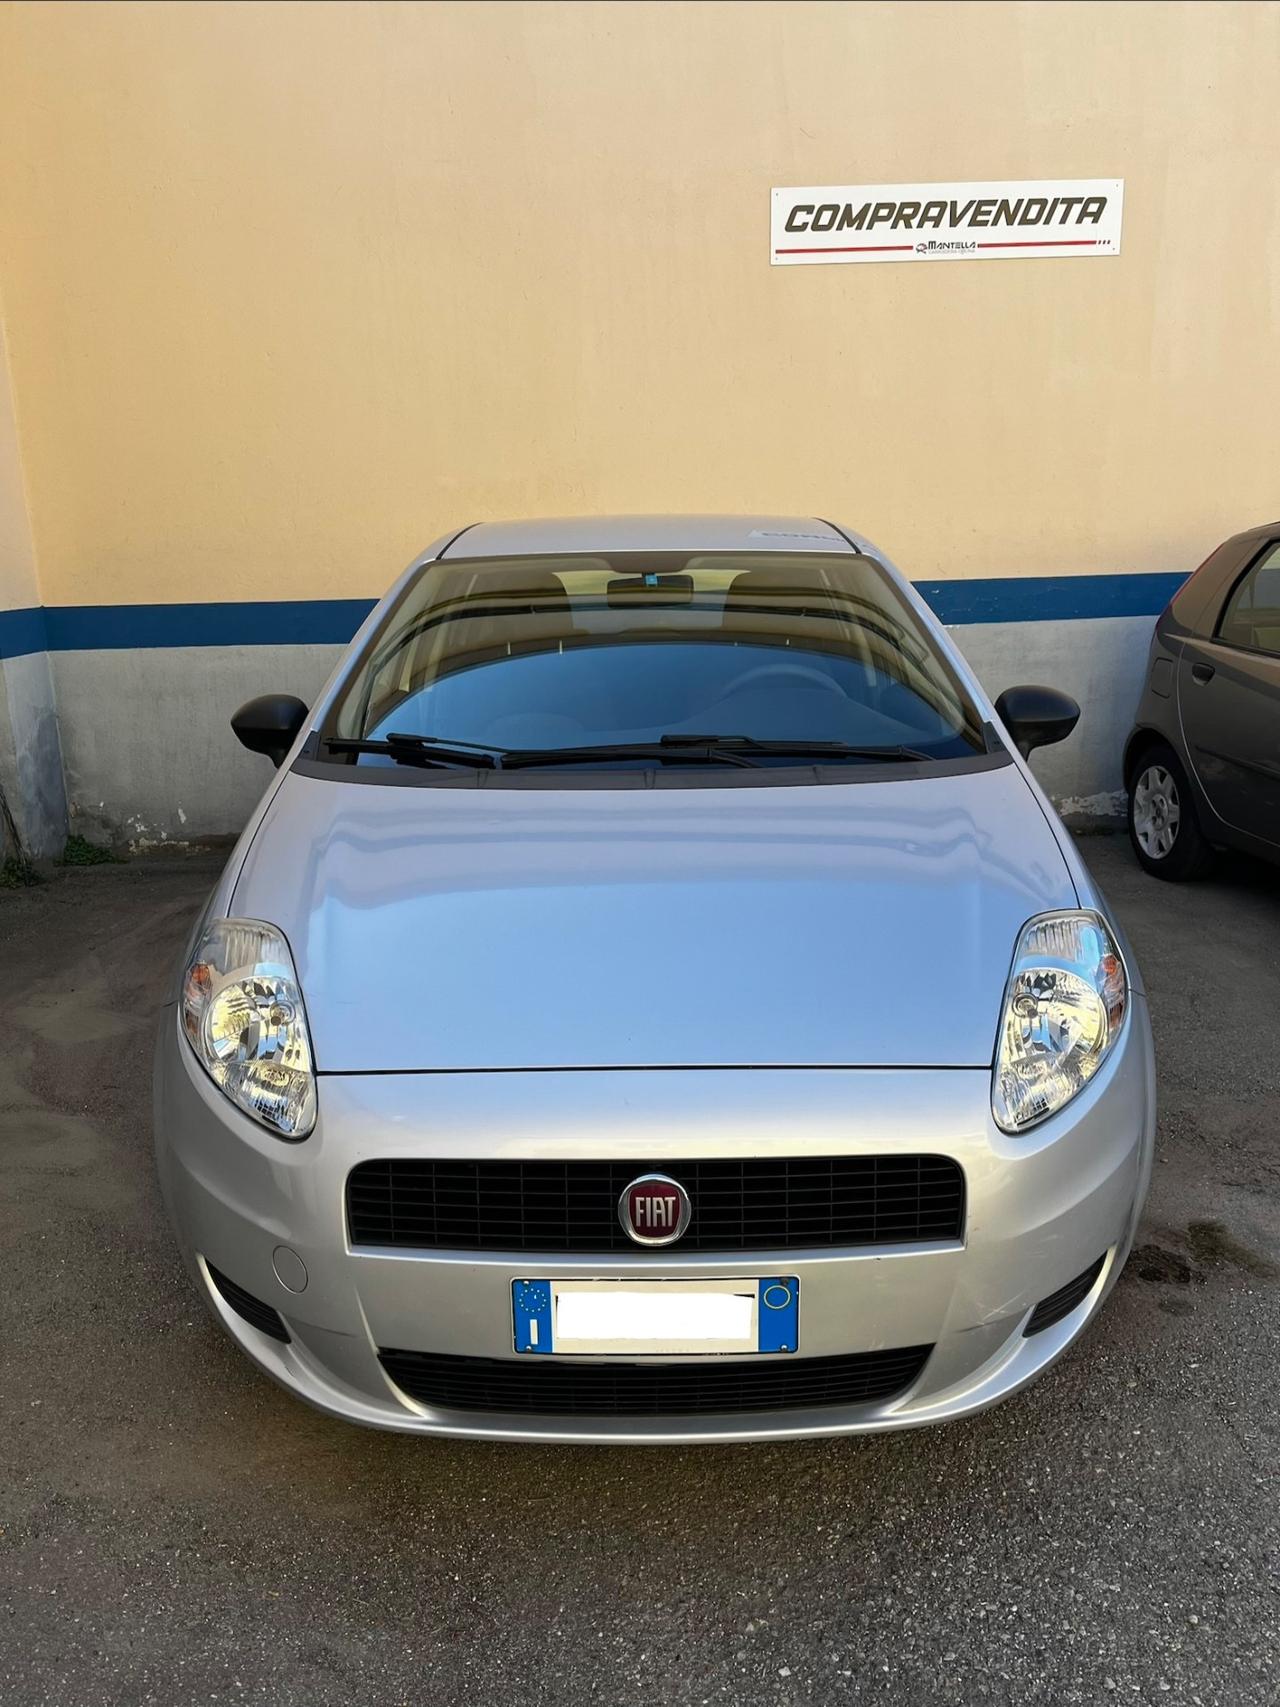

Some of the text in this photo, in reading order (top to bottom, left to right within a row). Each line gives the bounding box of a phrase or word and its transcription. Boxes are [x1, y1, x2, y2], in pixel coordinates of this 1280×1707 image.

[784, 196, 1108, 232] COMPRAVENDITA
[928, 240, 976, 250] MANTELLA
[635, 1196, 677, 1227] FIAT
